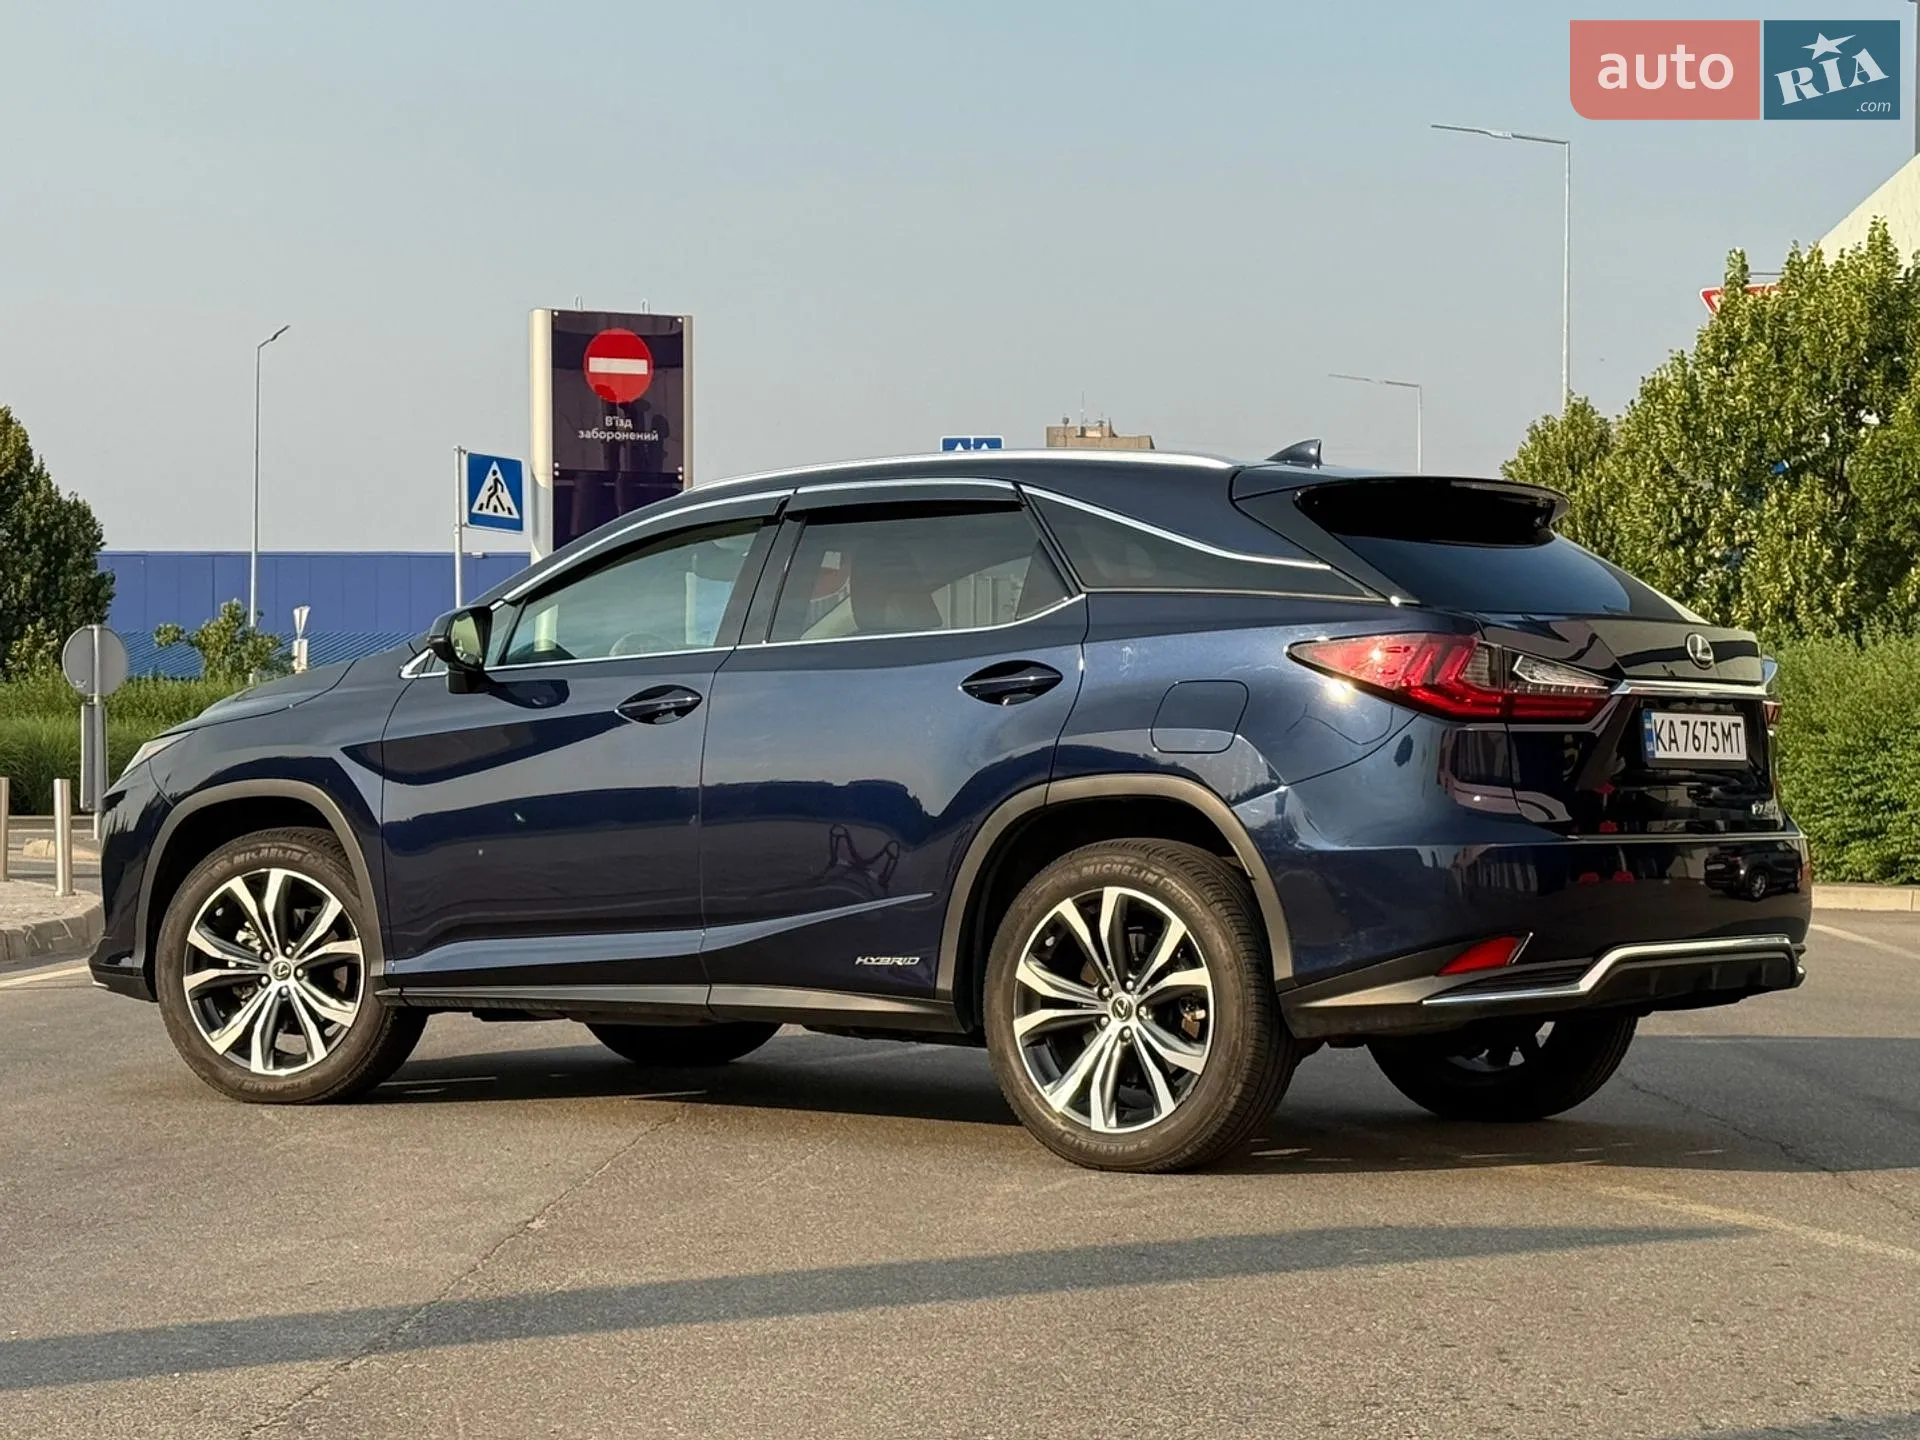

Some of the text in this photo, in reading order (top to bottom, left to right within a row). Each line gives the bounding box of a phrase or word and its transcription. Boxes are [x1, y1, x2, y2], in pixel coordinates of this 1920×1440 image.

[578, 428, 659, 442] заборонений
[1081, 862, 1160, 885] MICHELIN
[855, 956, 920, 966] HYBRID
